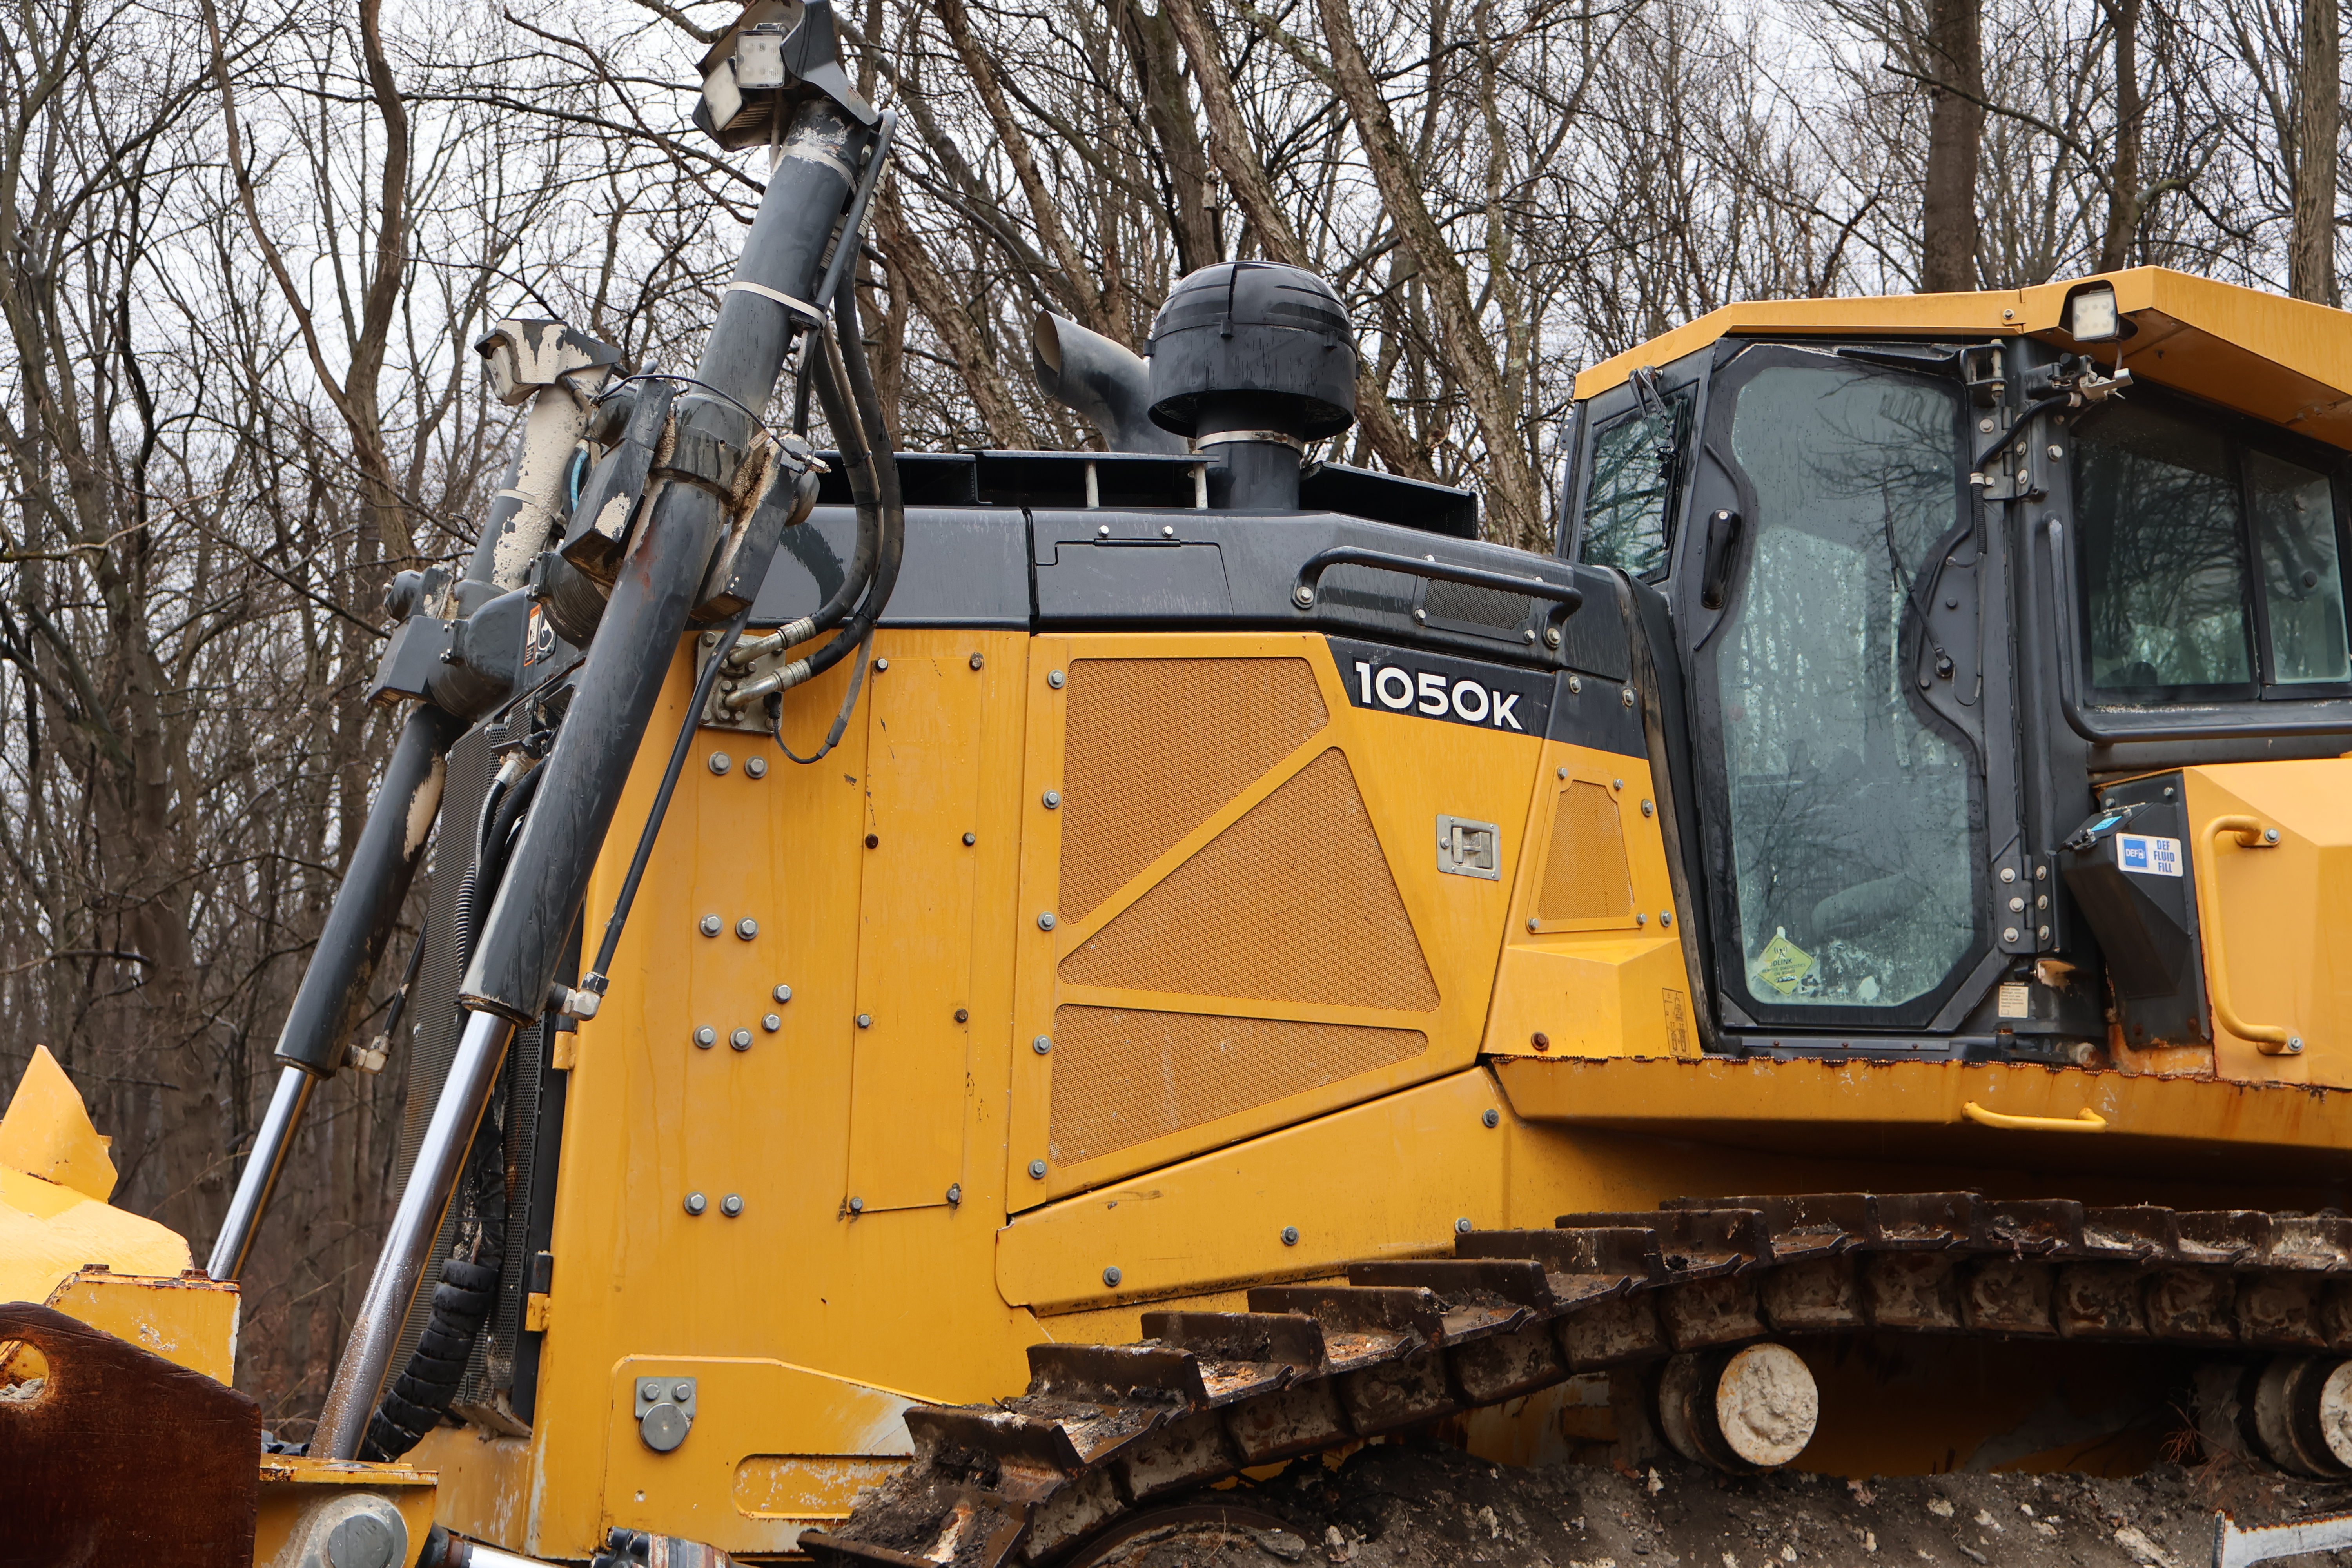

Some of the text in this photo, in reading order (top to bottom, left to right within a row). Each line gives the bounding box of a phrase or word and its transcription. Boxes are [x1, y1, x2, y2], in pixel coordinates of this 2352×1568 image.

[1356, 661, 1523, 730] 1050K
[2157, 840, 2170, 851] DEF
[2125, 848, 2138, 857] DEF
[2154, 850, 2175, 862] FLUID
[2158, 862, 2172, 873] FILL
